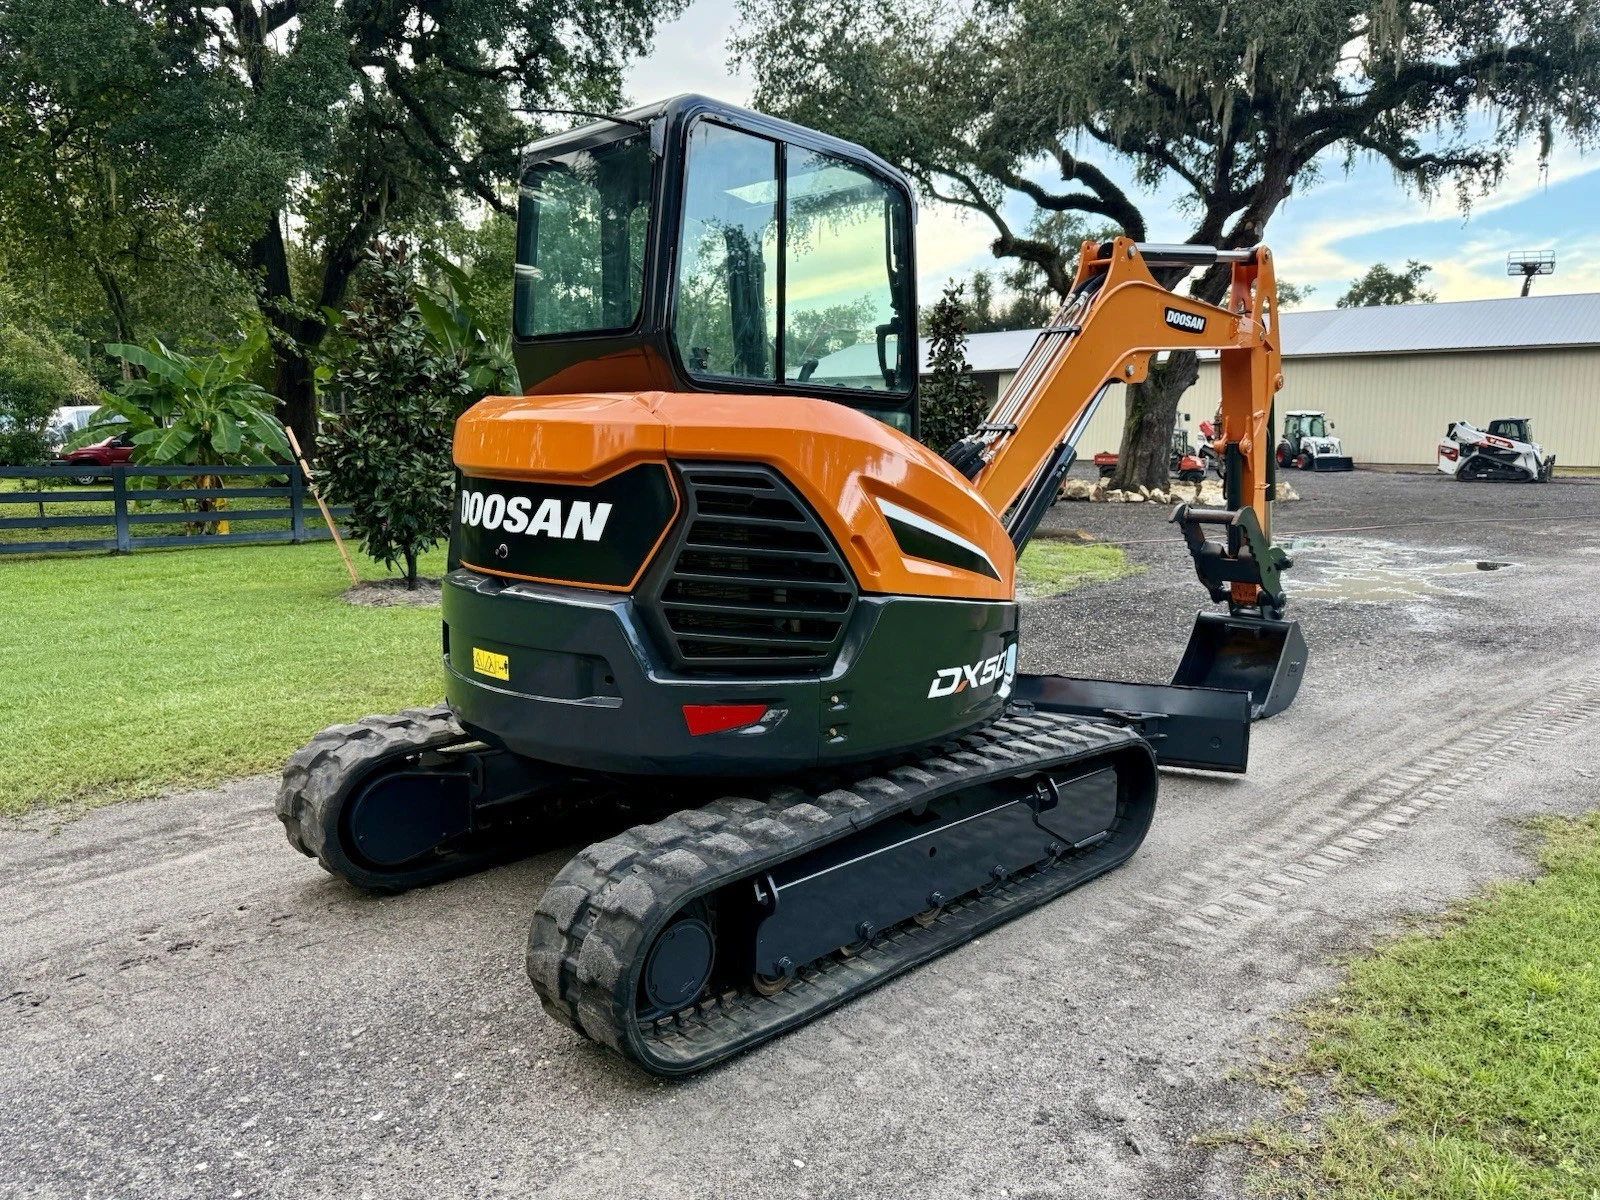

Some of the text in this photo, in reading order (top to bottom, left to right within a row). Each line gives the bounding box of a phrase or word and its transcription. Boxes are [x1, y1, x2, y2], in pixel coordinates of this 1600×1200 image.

[1166, 310, 1204, 330] DOOSAN
[461, 490, 612, 541] DOOSAN
[927, 649, 1007, 699] DX50
